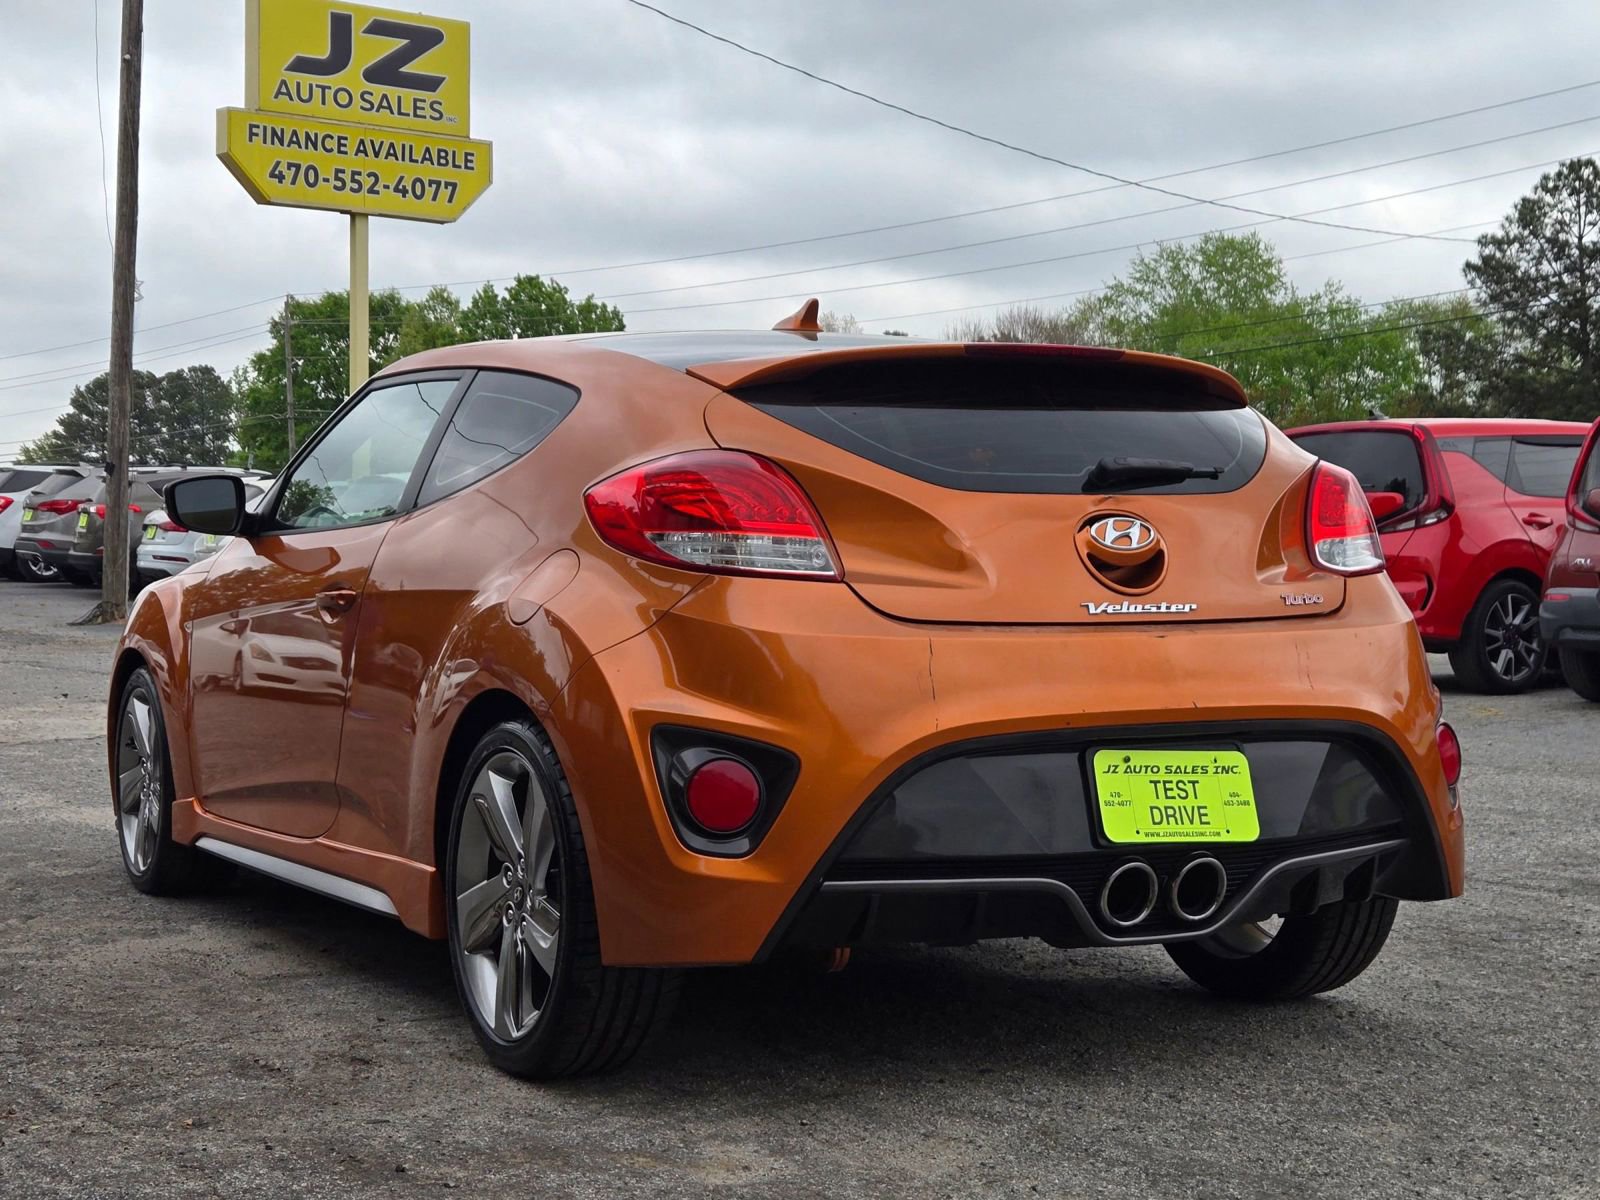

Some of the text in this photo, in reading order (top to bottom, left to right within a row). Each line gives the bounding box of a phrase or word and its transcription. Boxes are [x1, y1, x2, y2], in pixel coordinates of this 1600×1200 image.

[283, 11, 447, 93] JZ
[274, 79, 353, 108] AUTO
[360, 91, 444, 121] SALES
[248, 124, 475, 170] FINANCE AVAILABLE
[269, 161, 458, 203] 470-552-4077
[1081, 601, 1197, 614] Veloster
[1280, 592, 1323, 606] Turbo
[1103, 764, 1241, 774] JZ AUTO SALES INC.
[1149, 779, 1200, 800] TEST
[1150, 805, 1211, 826] DRIVE
